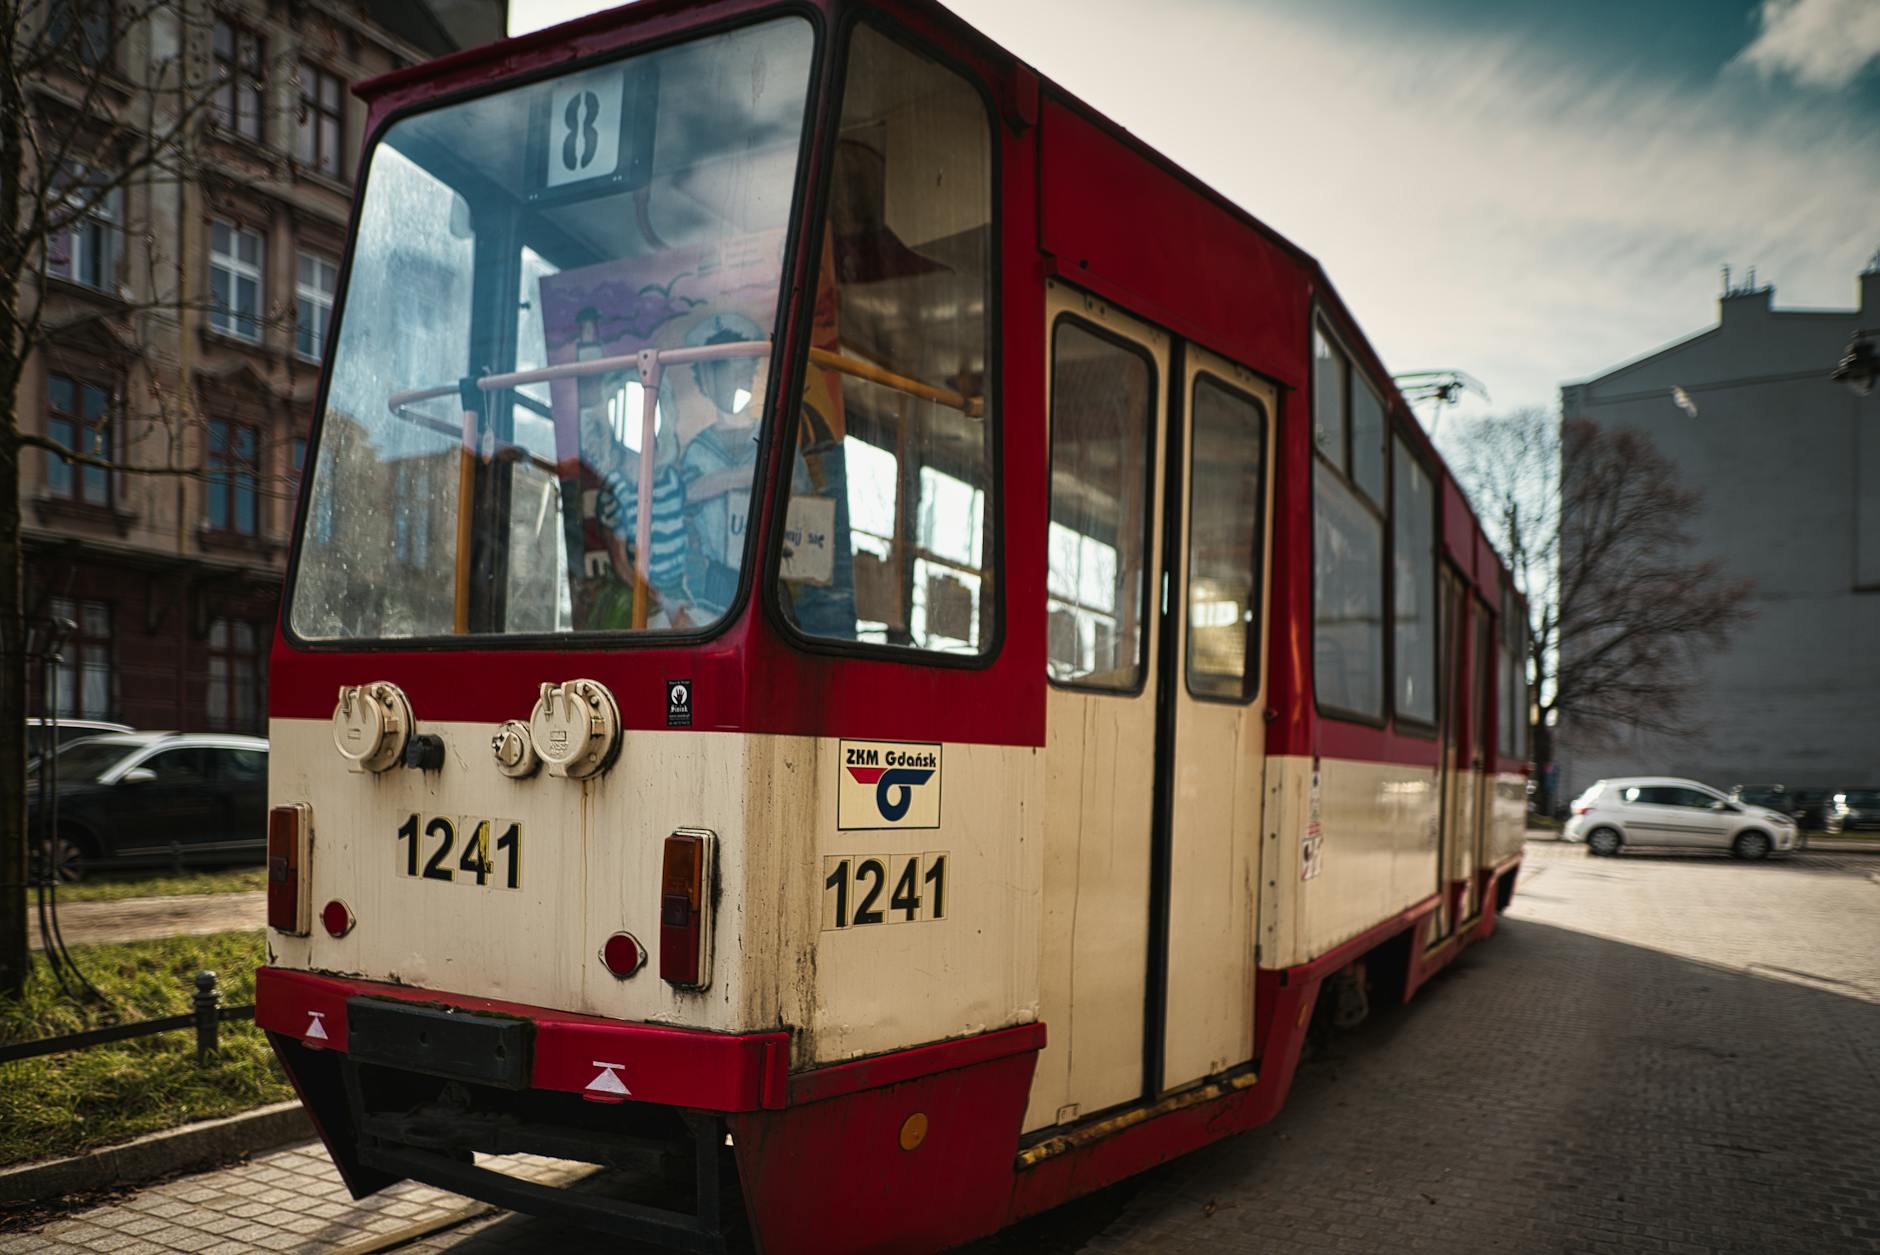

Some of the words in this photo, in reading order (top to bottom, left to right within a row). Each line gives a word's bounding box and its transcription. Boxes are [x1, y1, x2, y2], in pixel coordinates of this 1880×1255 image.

[563, 90, 600, 171] 8
[846, 748, 879, 766] ZKM
[885, 750, 937, 768] Gdańsk
[398, 812, 522, 889] 1241
[825, 855, 947, 928] 1241
